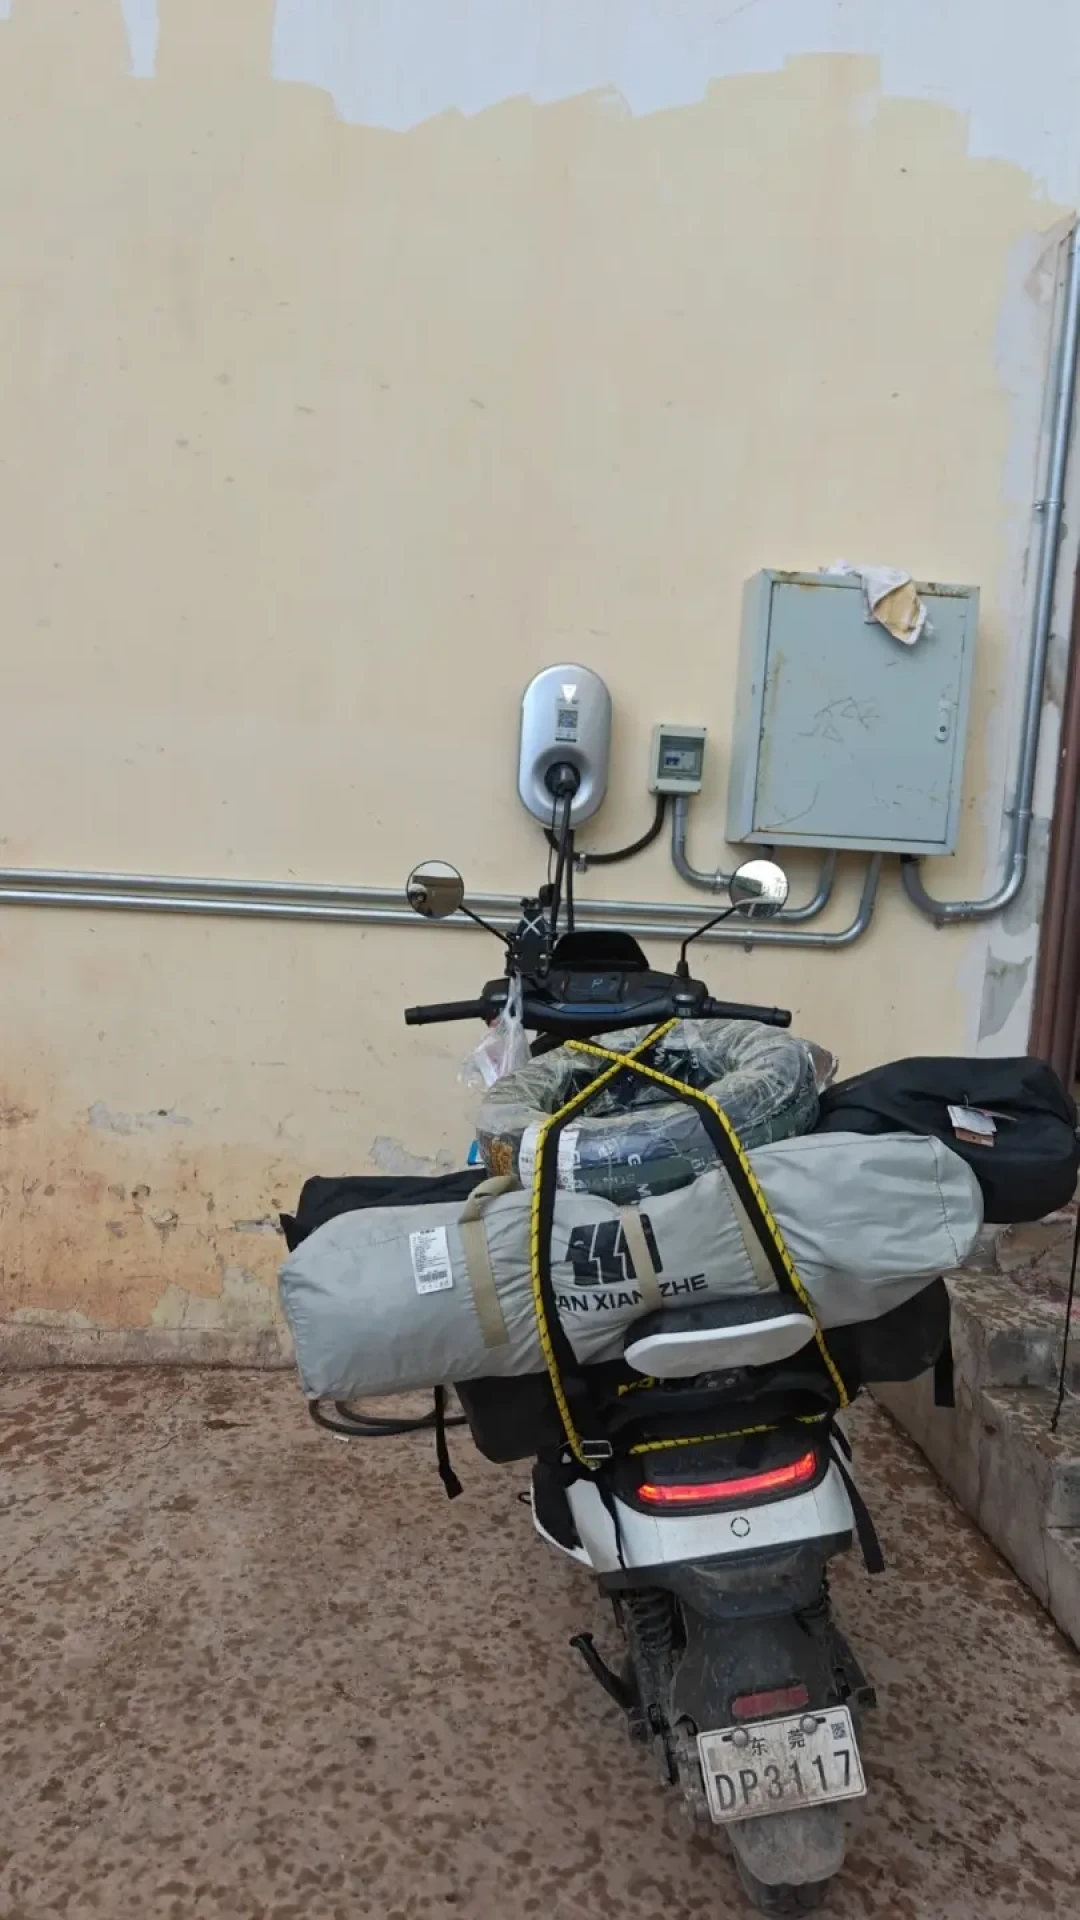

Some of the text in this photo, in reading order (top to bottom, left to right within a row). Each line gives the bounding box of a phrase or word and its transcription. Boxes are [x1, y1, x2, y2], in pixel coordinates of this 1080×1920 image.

[559, 1295, 589, 1311] AN
[659, 1273, 708, 1297] ZHE
[751, 1728, 806, 1756] 东莞
[715, 1750, 850, 1810] DP3117
